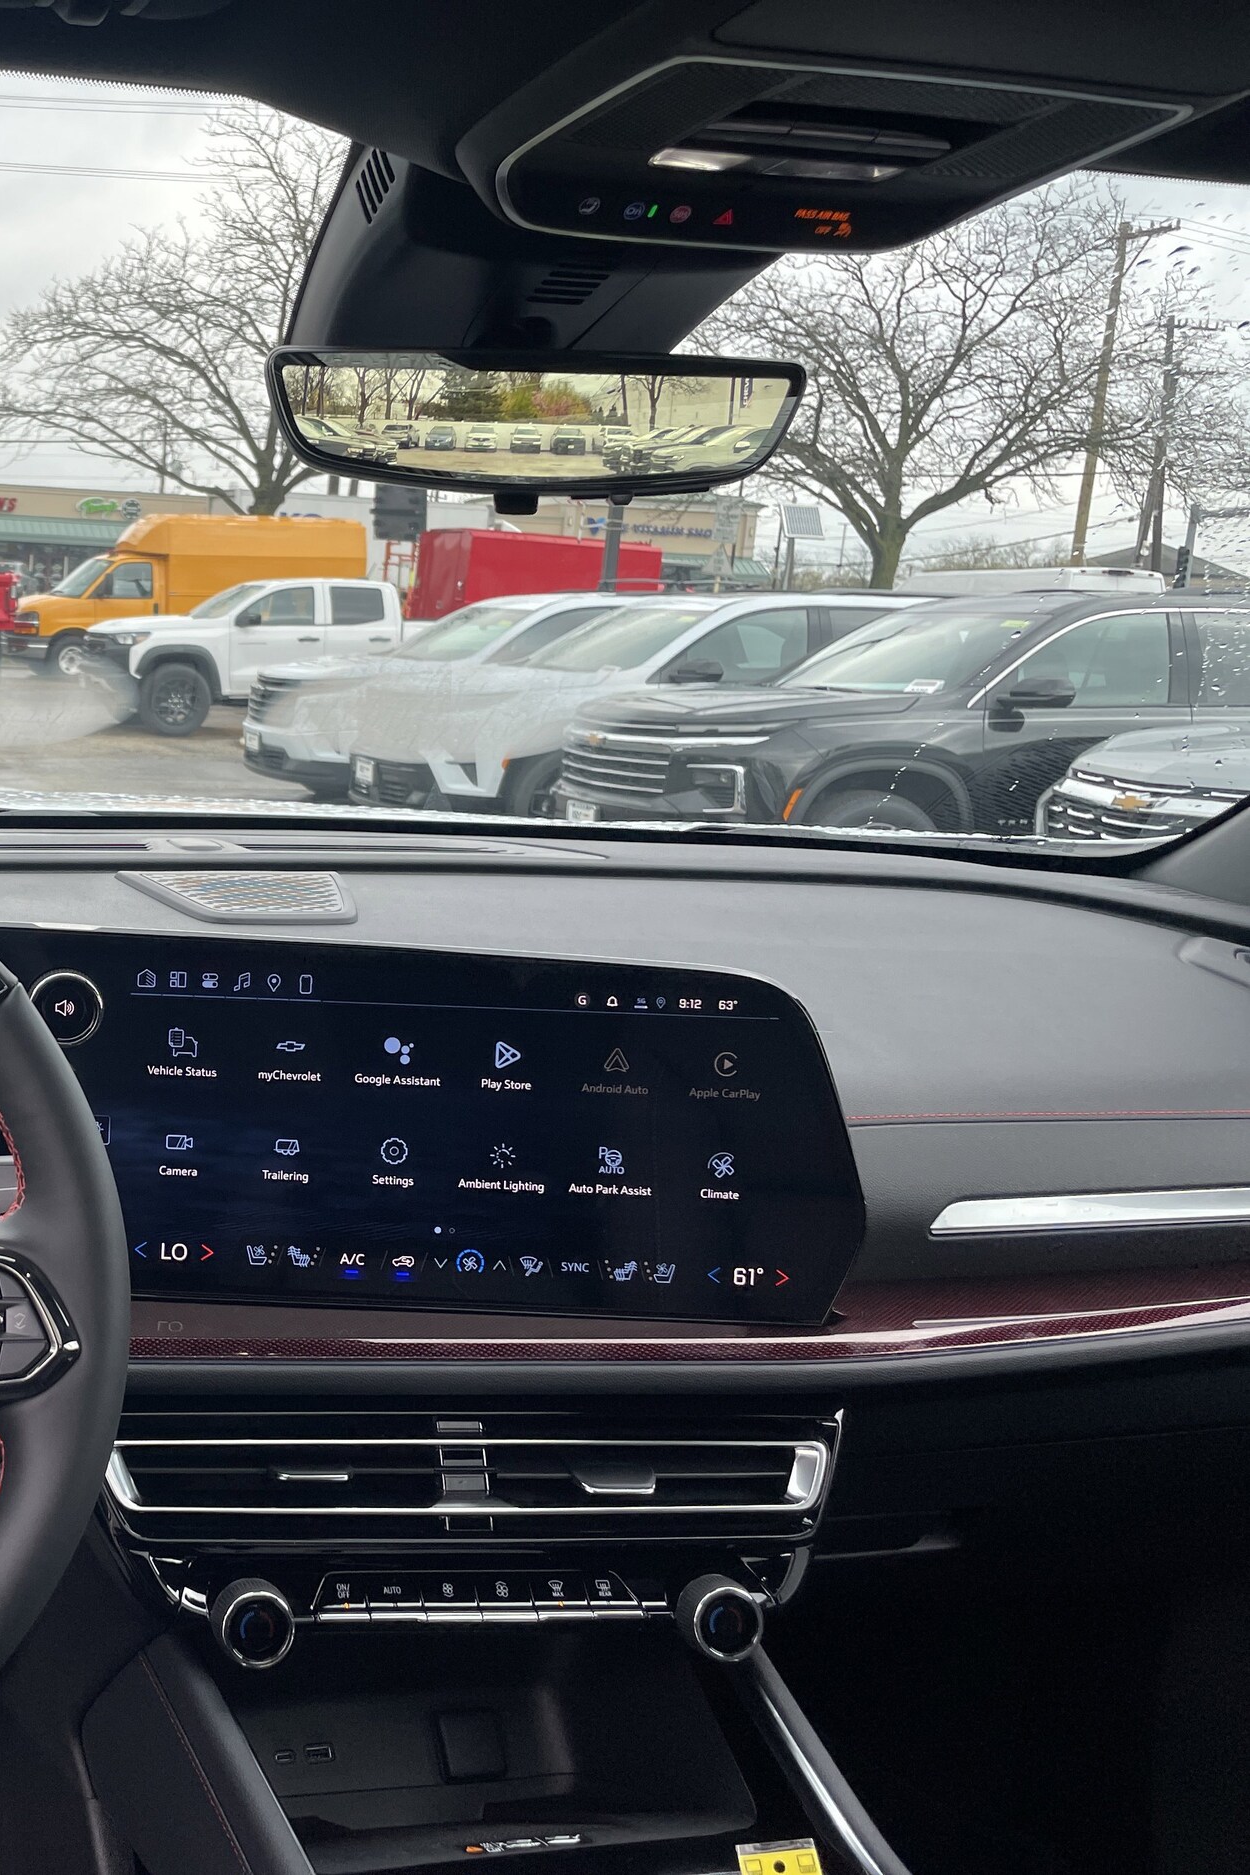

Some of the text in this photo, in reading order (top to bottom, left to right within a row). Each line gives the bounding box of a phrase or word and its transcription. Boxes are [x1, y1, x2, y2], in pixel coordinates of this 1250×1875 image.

[794, 209, 818, 219] PASS
[577, 995, 587, 1005] G
[678, 998, 702, 1009] 9:12
[718, 1000, 738, 1011] 63°
[147, 1065, 217, 1078] Vehicle Status
[258, 1069, 321, 1082] myChevrolet
[354, 1073, 441, 1087] Google Assistant
[481, 1078, 532, 1092] Play Store
[581, 1083, 649, 1095] Android Auto
[689, 1087, 761, 1102] Apple CarPlay
[158, 1165, 198, 1177] Camera
[598, 1165, 625, 1174] AUTO
[261, 1169, 309, 1184] Trailering
[372, 1174, 414, 1189] Settings
[457, 1178, 545, 1194] Ambient Lighting
[568, 1183, 652, 1196] Auto Park Assist
[700, 1188, 740, 1200] Climate
[160, 1242, 188, 1261] LO
[339, 1253, 365, 1266] A/C
[561, 1261, 590, 1273] SYNC
[733, 1267, 764, 1286] 61°
[336, 1583, 350, 1592] ON/
[383, 1586, 402, 1595] AUTO
[338, 1591, 350, 1599] OFF
